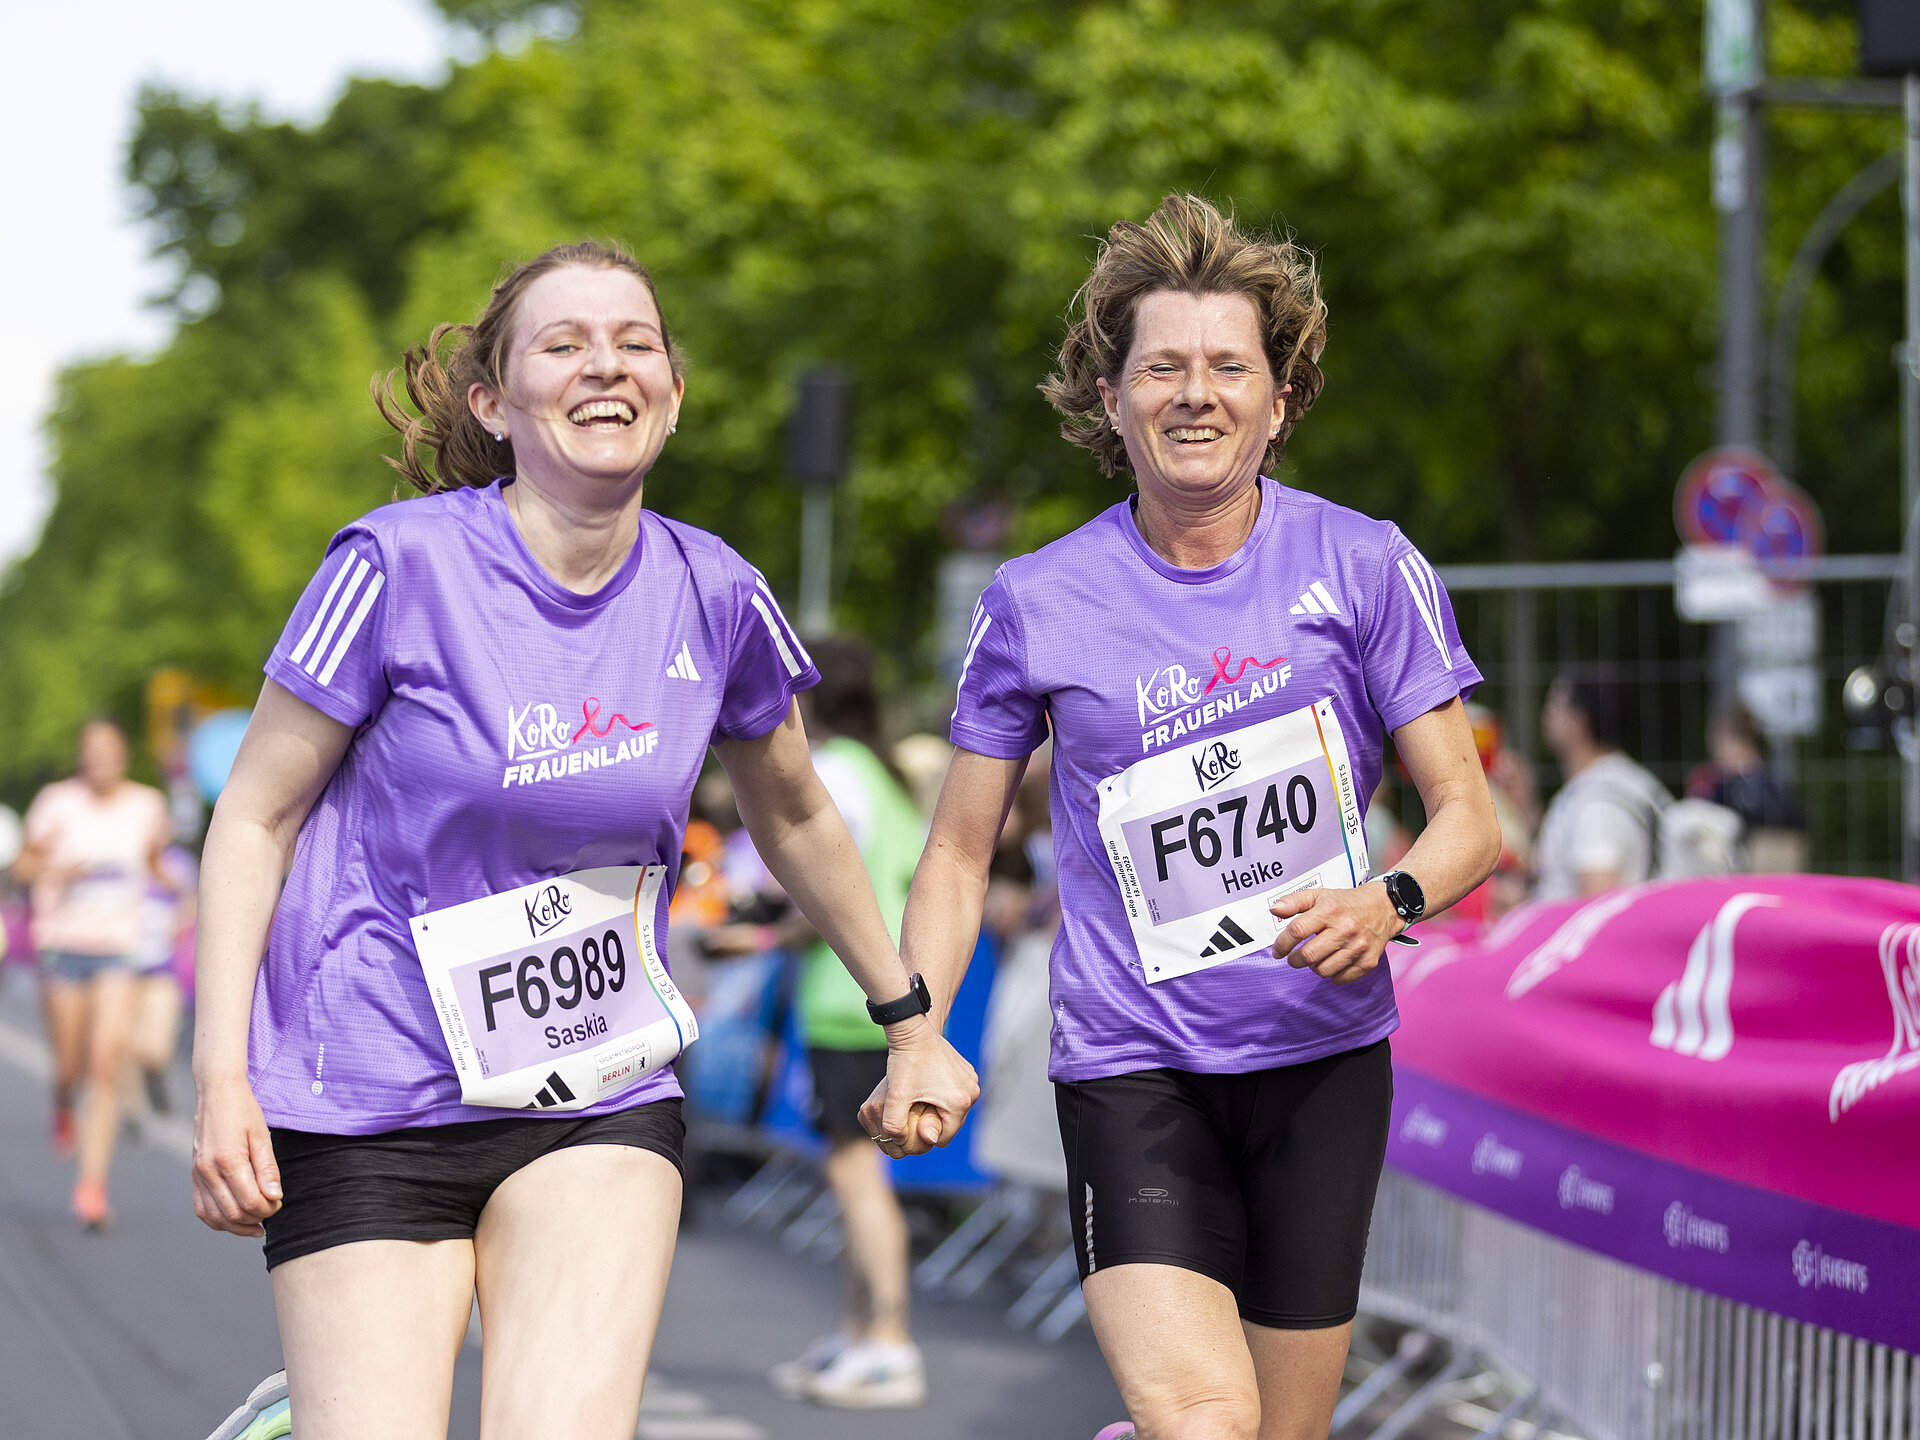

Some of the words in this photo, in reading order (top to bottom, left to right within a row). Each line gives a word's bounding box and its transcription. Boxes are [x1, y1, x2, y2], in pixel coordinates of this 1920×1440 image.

[1136, 664, 1201, 727] KoRo
[1141, 664, 1292, 753] FRAUENLAUF
[508, 701, 571, 760] KoRo
[502, 731, 658, 788] FRAUENLAUF
[1192, 741, 1241, 792] KoRo
[1339, 764, 1352, 807] EVENTS
[1150, 774, 1317, 882] F6740
[1109, 841, 1119, 861] Berlin
[1122, 855, 1132, 872] 2023
[1114, 861, 1132, 898] Frauenlauf
[1128, 873, 1137, 887] Mai
[1221, 861, 1284, 894] Heike
[524, 885, 572, 938] KoRo
[1128, 900, 1138, 918] KoRo
[643, 924, 659, 973] EVENTS
[478, 929, 626, 1032] F6989
[450, 1004, 460, 1021] 2023
[544, 1012, 608, 1049] Saskia
[602, 1065, 631, 1083] BERLIN
